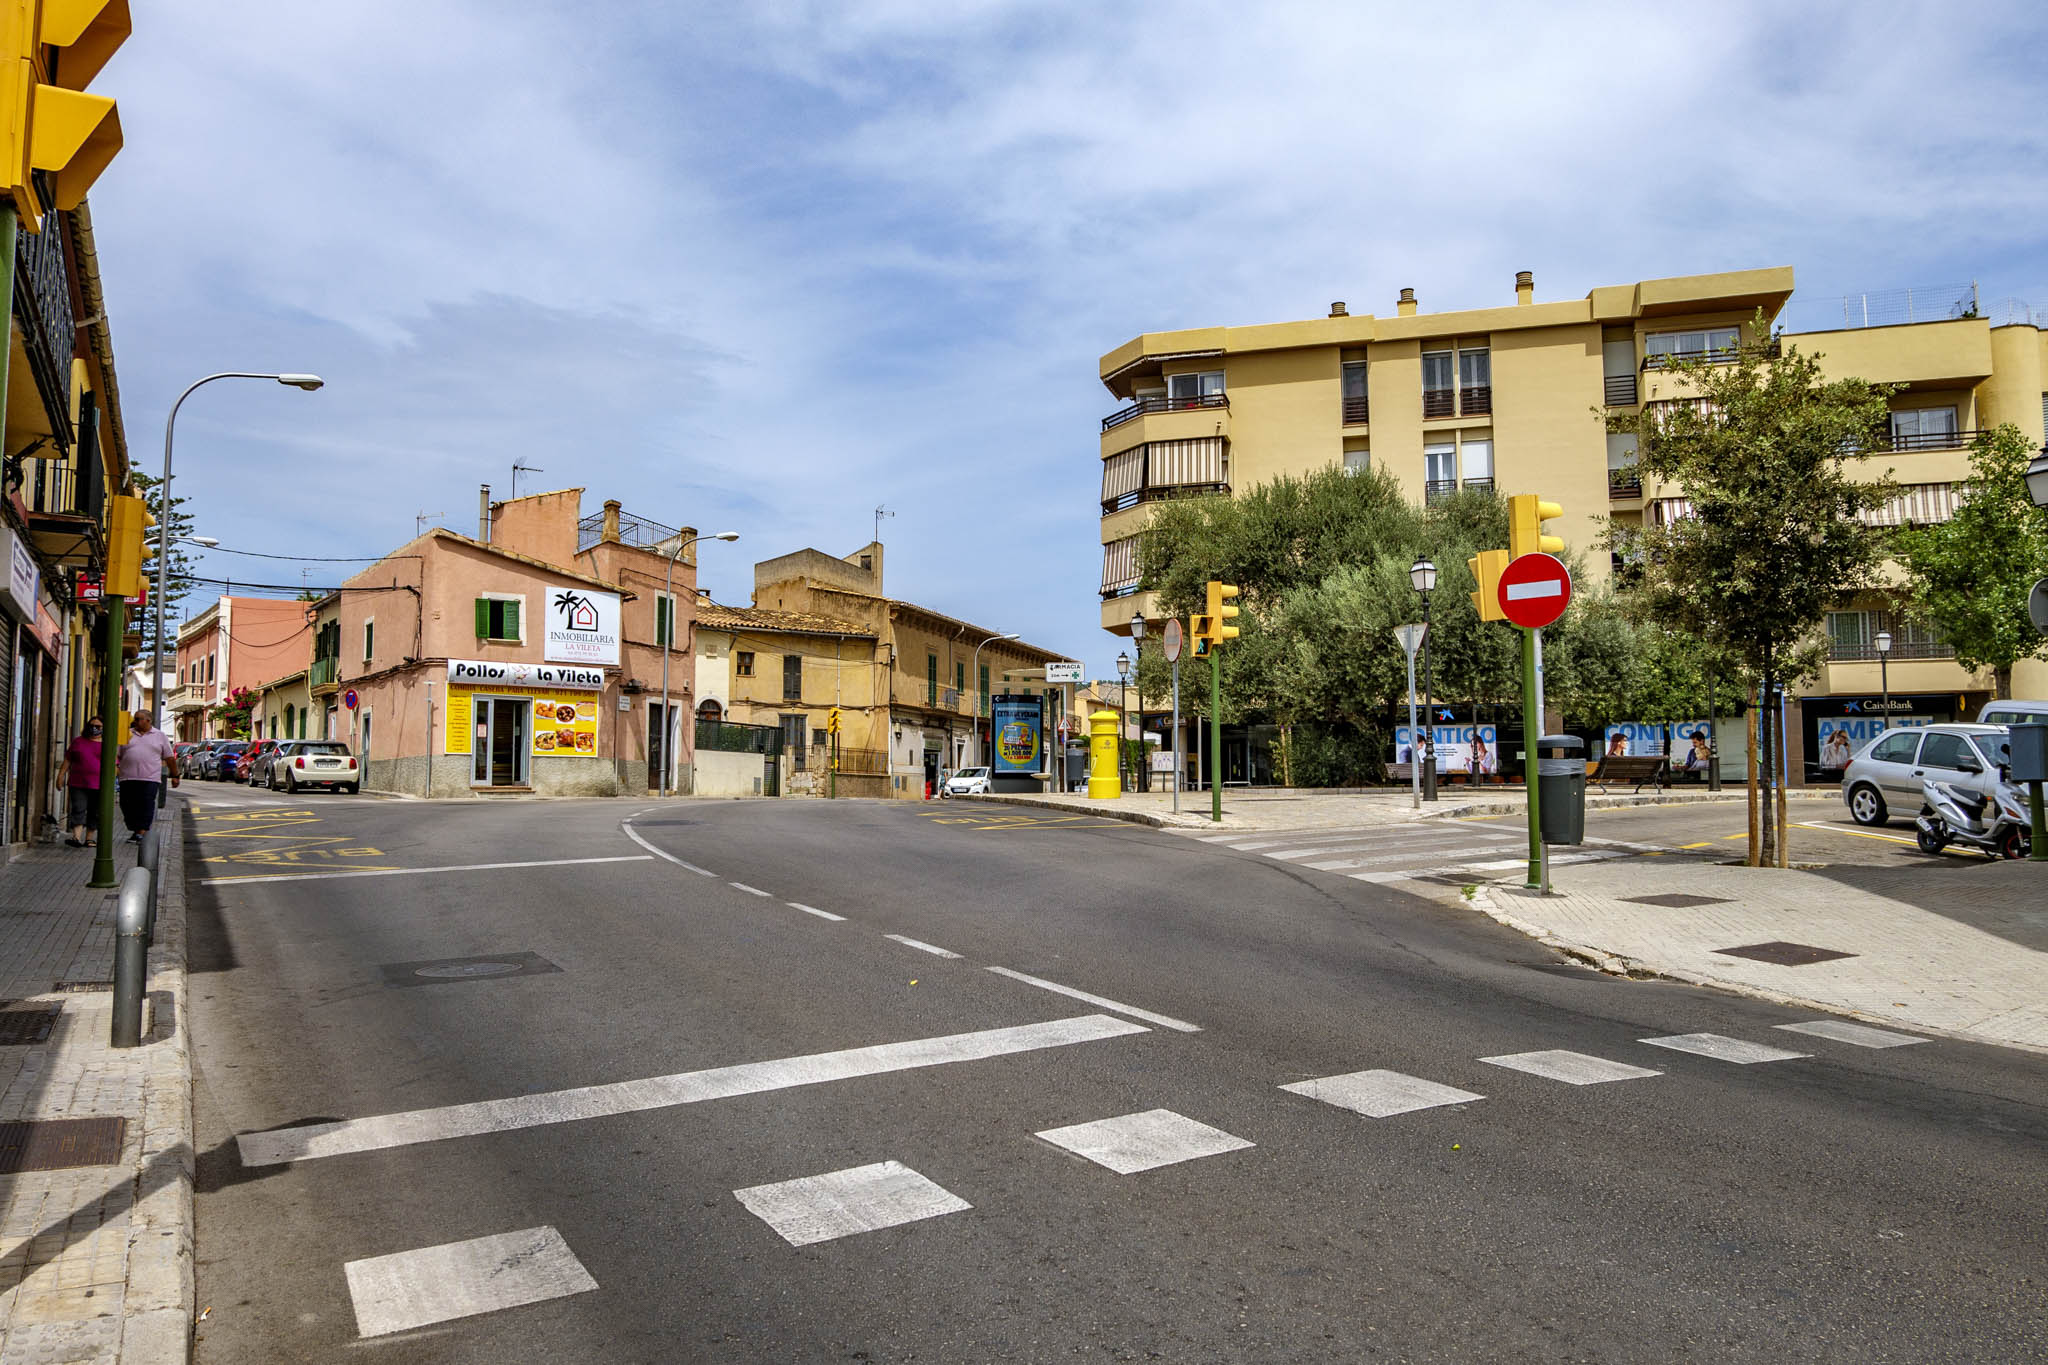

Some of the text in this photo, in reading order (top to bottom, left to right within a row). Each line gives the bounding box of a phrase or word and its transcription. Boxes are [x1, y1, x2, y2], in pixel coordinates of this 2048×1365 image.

[550, 631, 615, 644] INMOBILIARIA
[576, 643, 601, 652] VILETA
[456, 663, 505, 678] Pollos
[557, 669, 601, 684] Vileta
[1819, 720, 1885, 739] AMB
